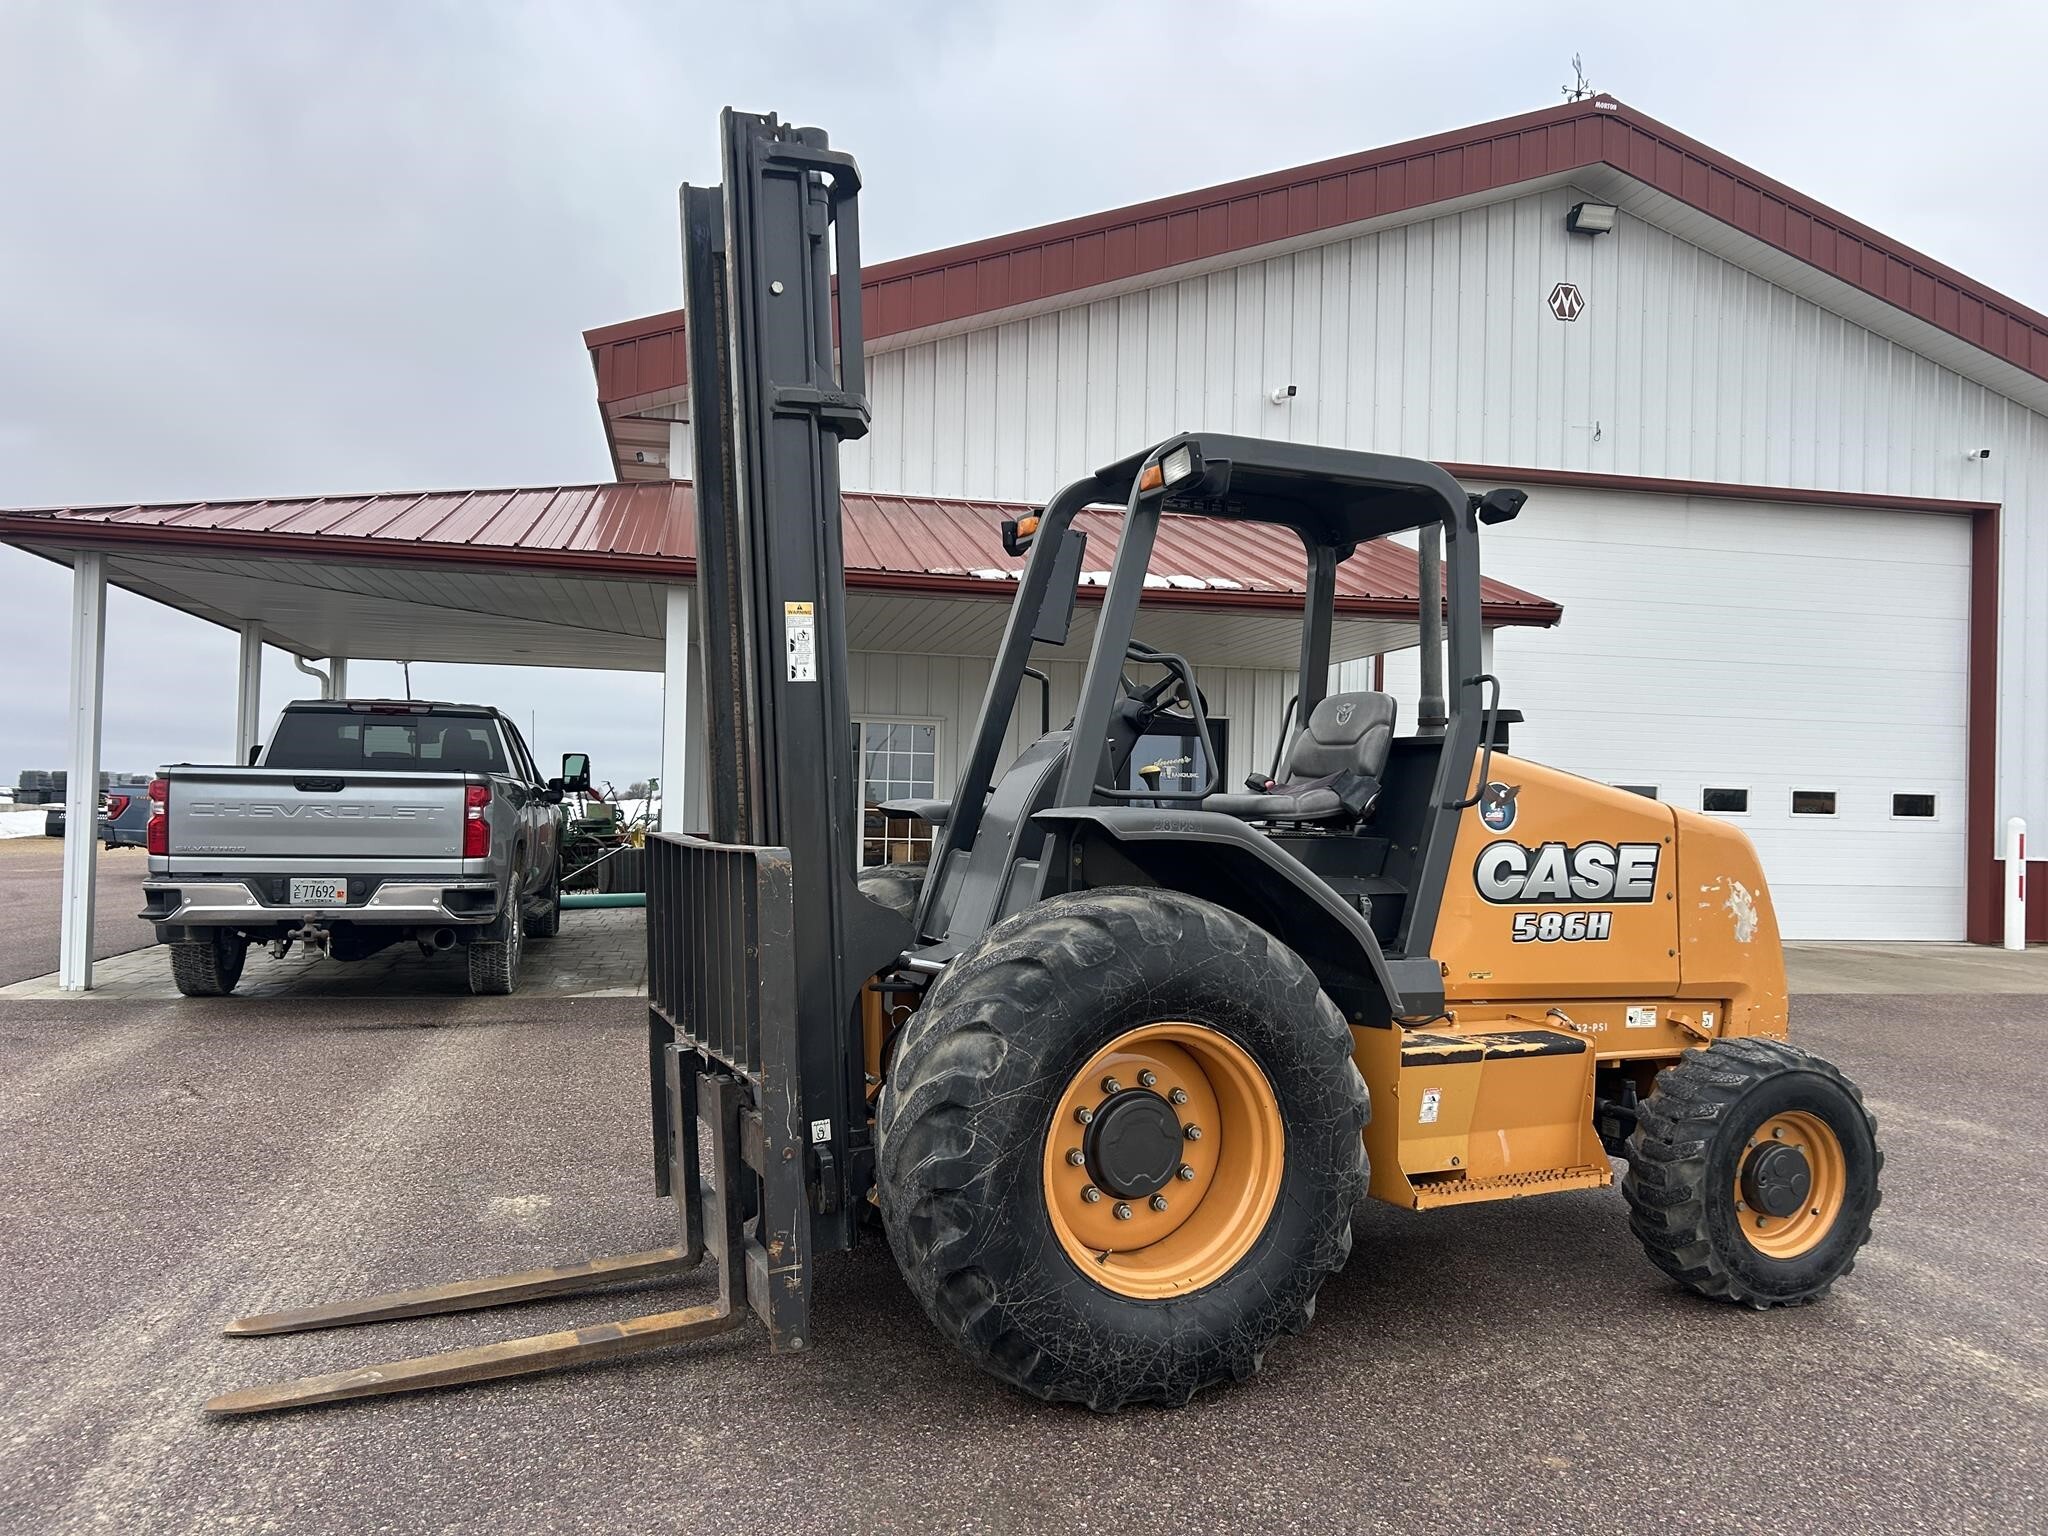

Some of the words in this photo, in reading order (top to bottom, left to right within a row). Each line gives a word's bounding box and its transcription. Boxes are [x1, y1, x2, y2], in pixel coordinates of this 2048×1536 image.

[1594, 101, 1617, 110] MORTON
[188, 802, 446, 820] CHEVROLET
[1475, 841, 1660, 902] CASE
[302, 885, 335, 898] 77692
[1512, 911, 1613, 942] 586H
